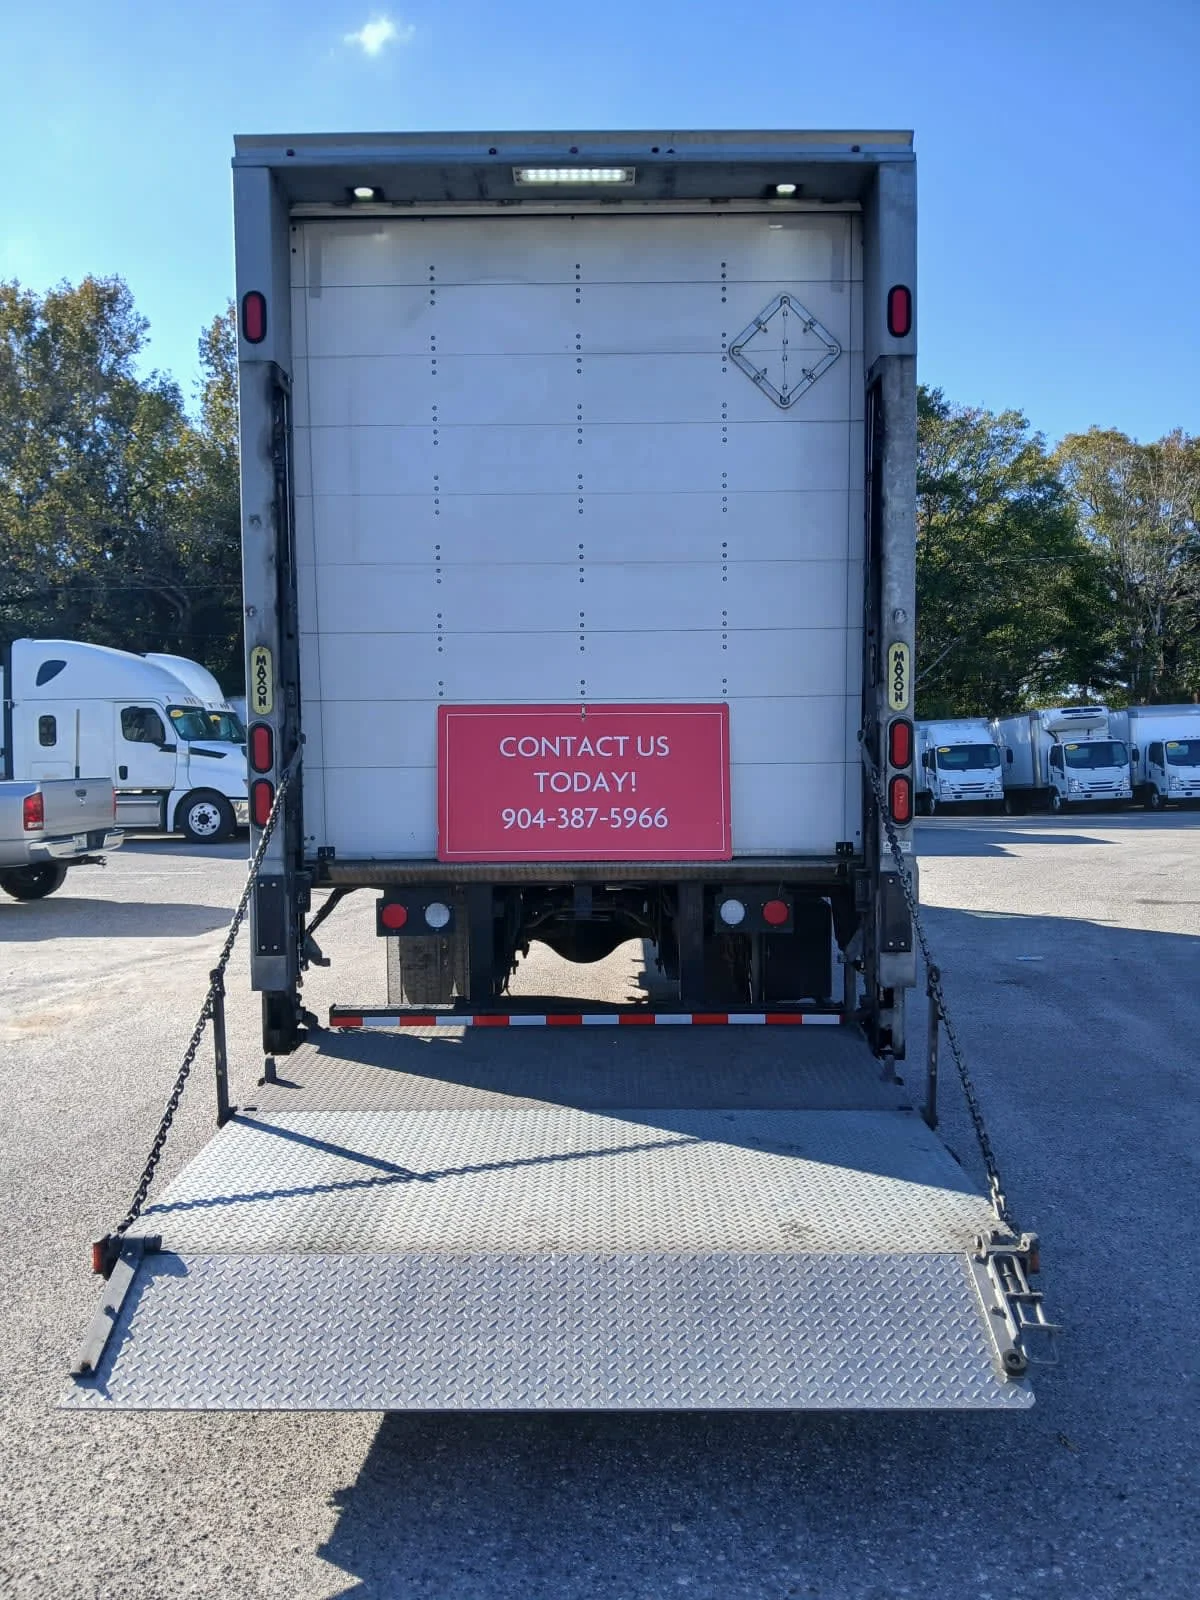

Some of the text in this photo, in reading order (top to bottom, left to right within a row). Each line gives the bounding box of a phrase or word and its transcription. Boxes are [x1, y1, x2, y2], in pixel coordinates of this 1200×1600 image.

[256, 655, 267, 706] MAXON
[894, 651, 904, 702] MAXON
[499, 735, 670, 757] CONTACT US
[533, 771, 637, 793] TODAY!
[501, 807, 669, 829] 904-387-5966
